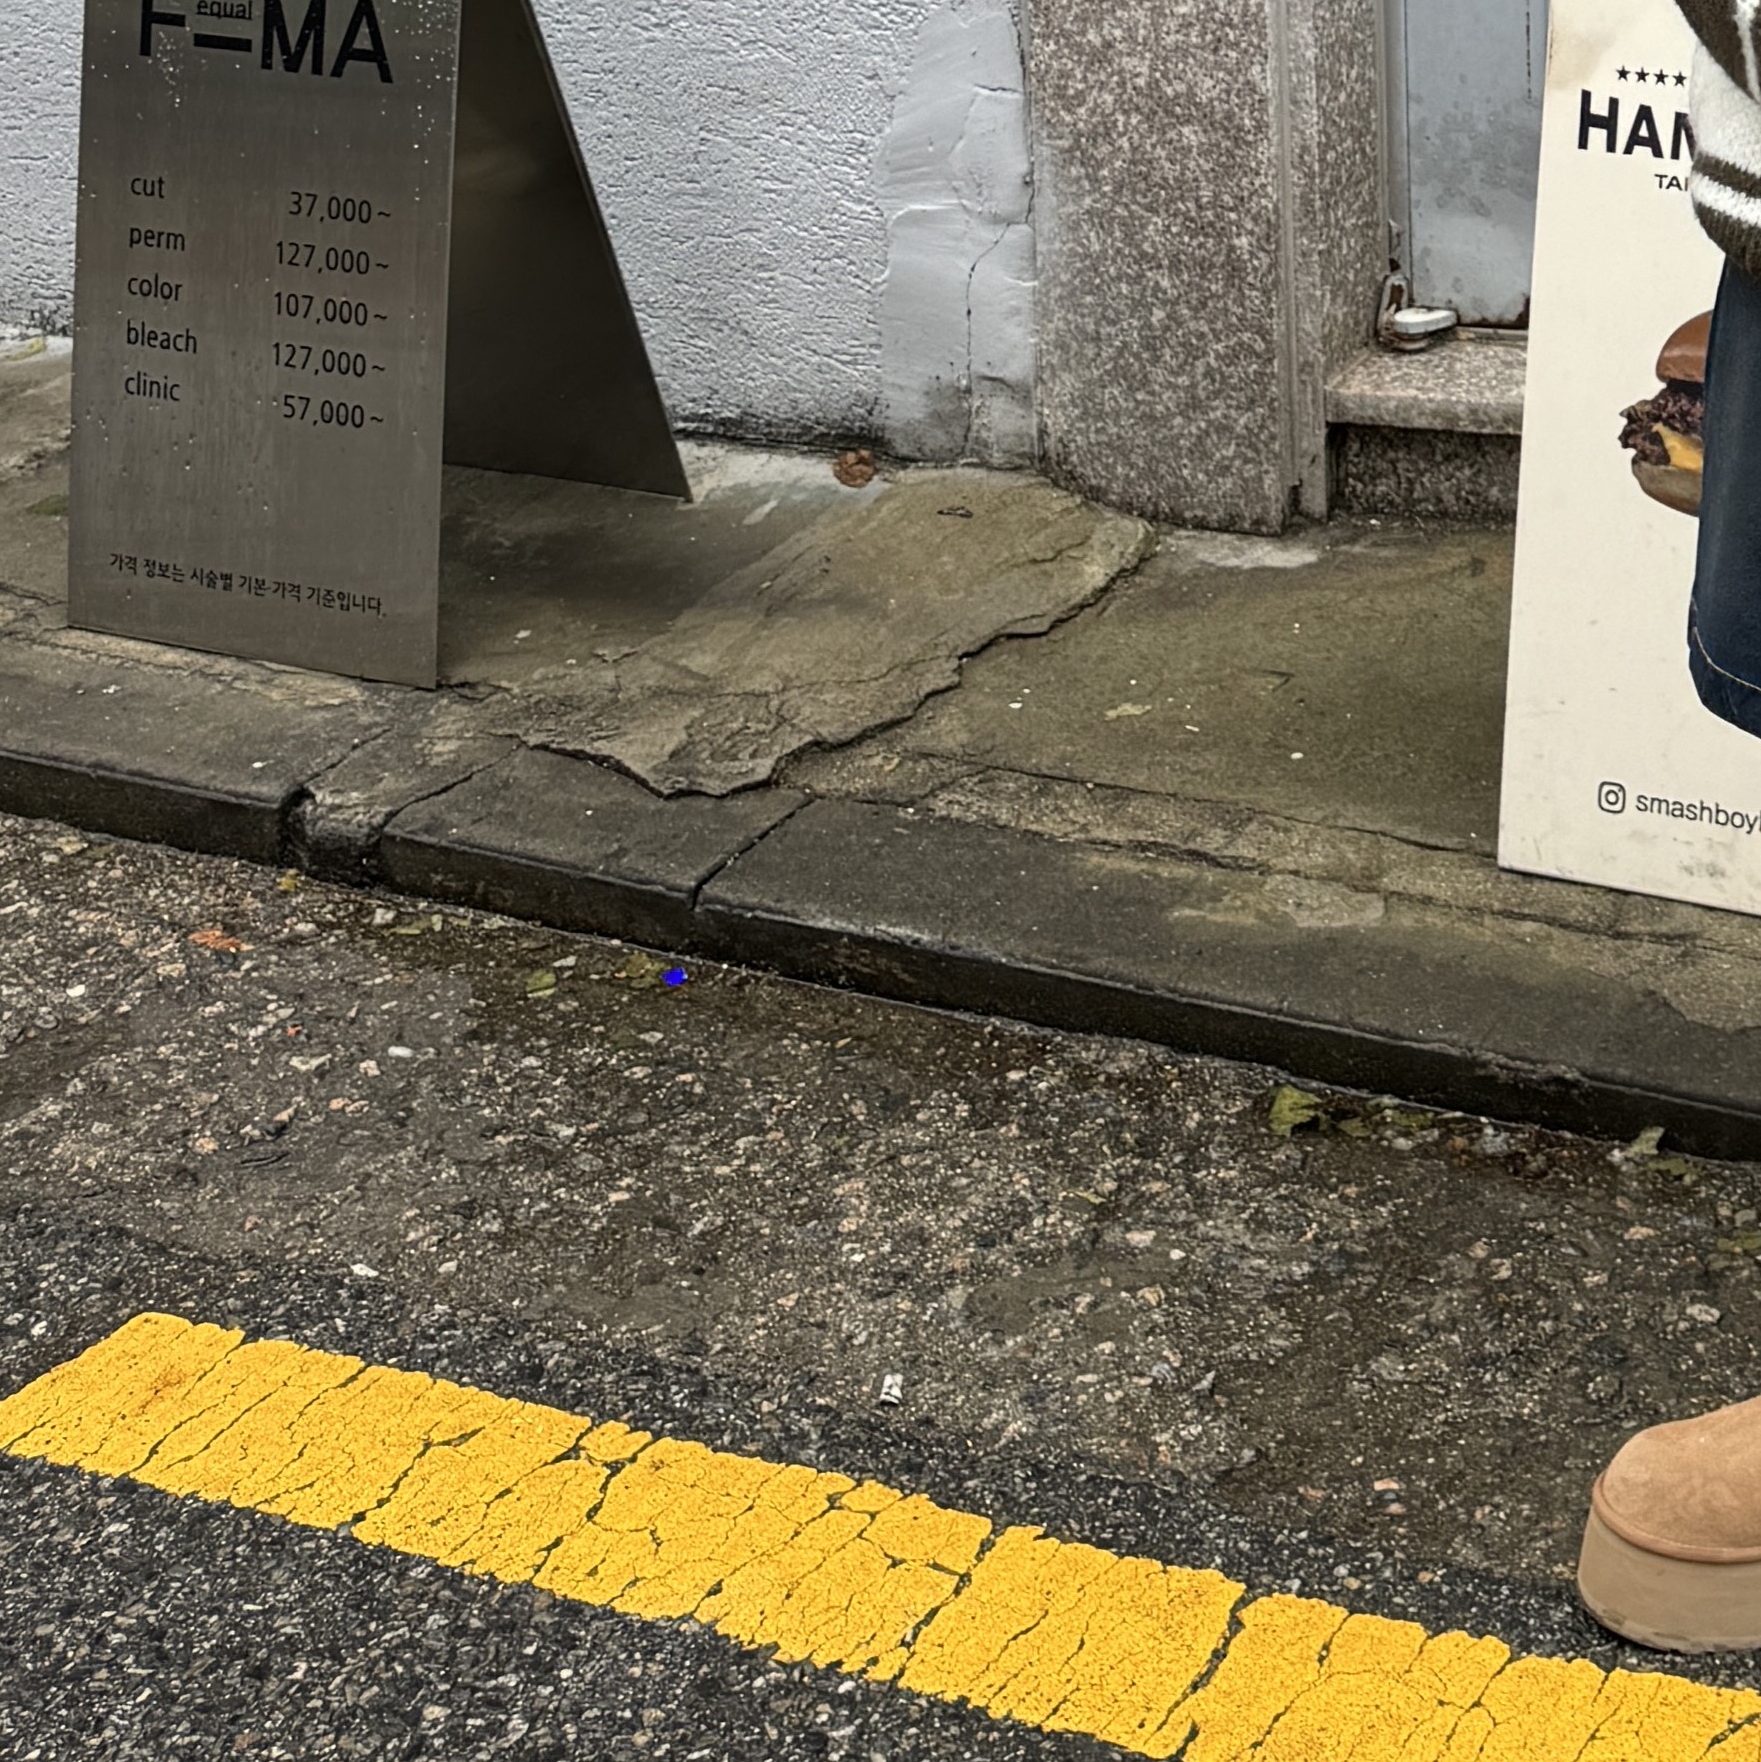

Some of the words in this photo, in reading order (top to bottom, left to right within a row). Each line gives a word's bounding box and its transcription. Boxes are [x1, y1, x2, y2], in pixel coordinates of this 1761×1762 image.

[130, 176, 165, 199] cut
[128, 226, 186, 252] perm
[127, 273, 183, 301] color
[126, 319, 198, 354] bleach
[124, 371, 181, 401] clinic
[109, 553, 138, 576] 가격
[142, 557, 186, 583] 정보는
[190, 567, 234, 592] 시술별
